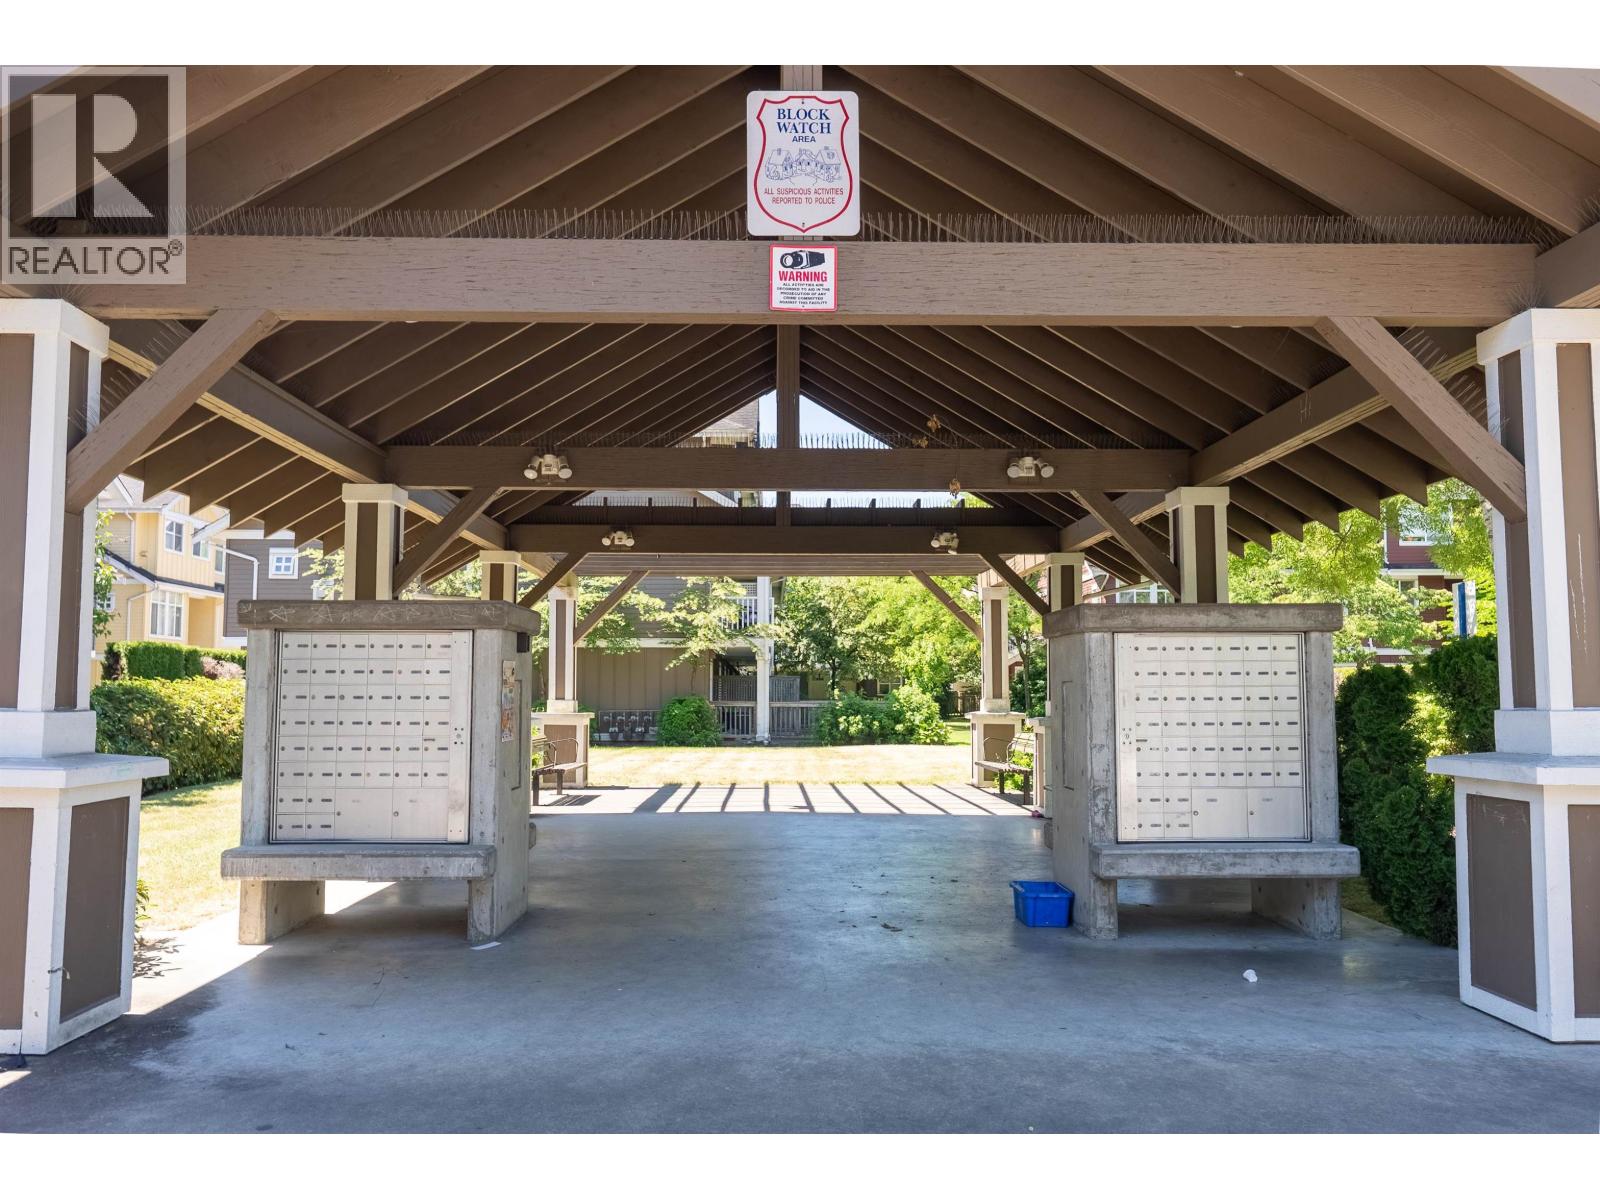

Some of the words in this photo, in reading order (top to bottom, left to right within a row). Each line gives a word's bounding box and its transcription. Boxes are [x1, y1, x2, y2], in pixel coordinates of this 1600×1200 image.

[777, 109, 830, 120] BLOCK
[777, 122, 831, 134] WATCH
[779, 271, 827, 281] WARNING
